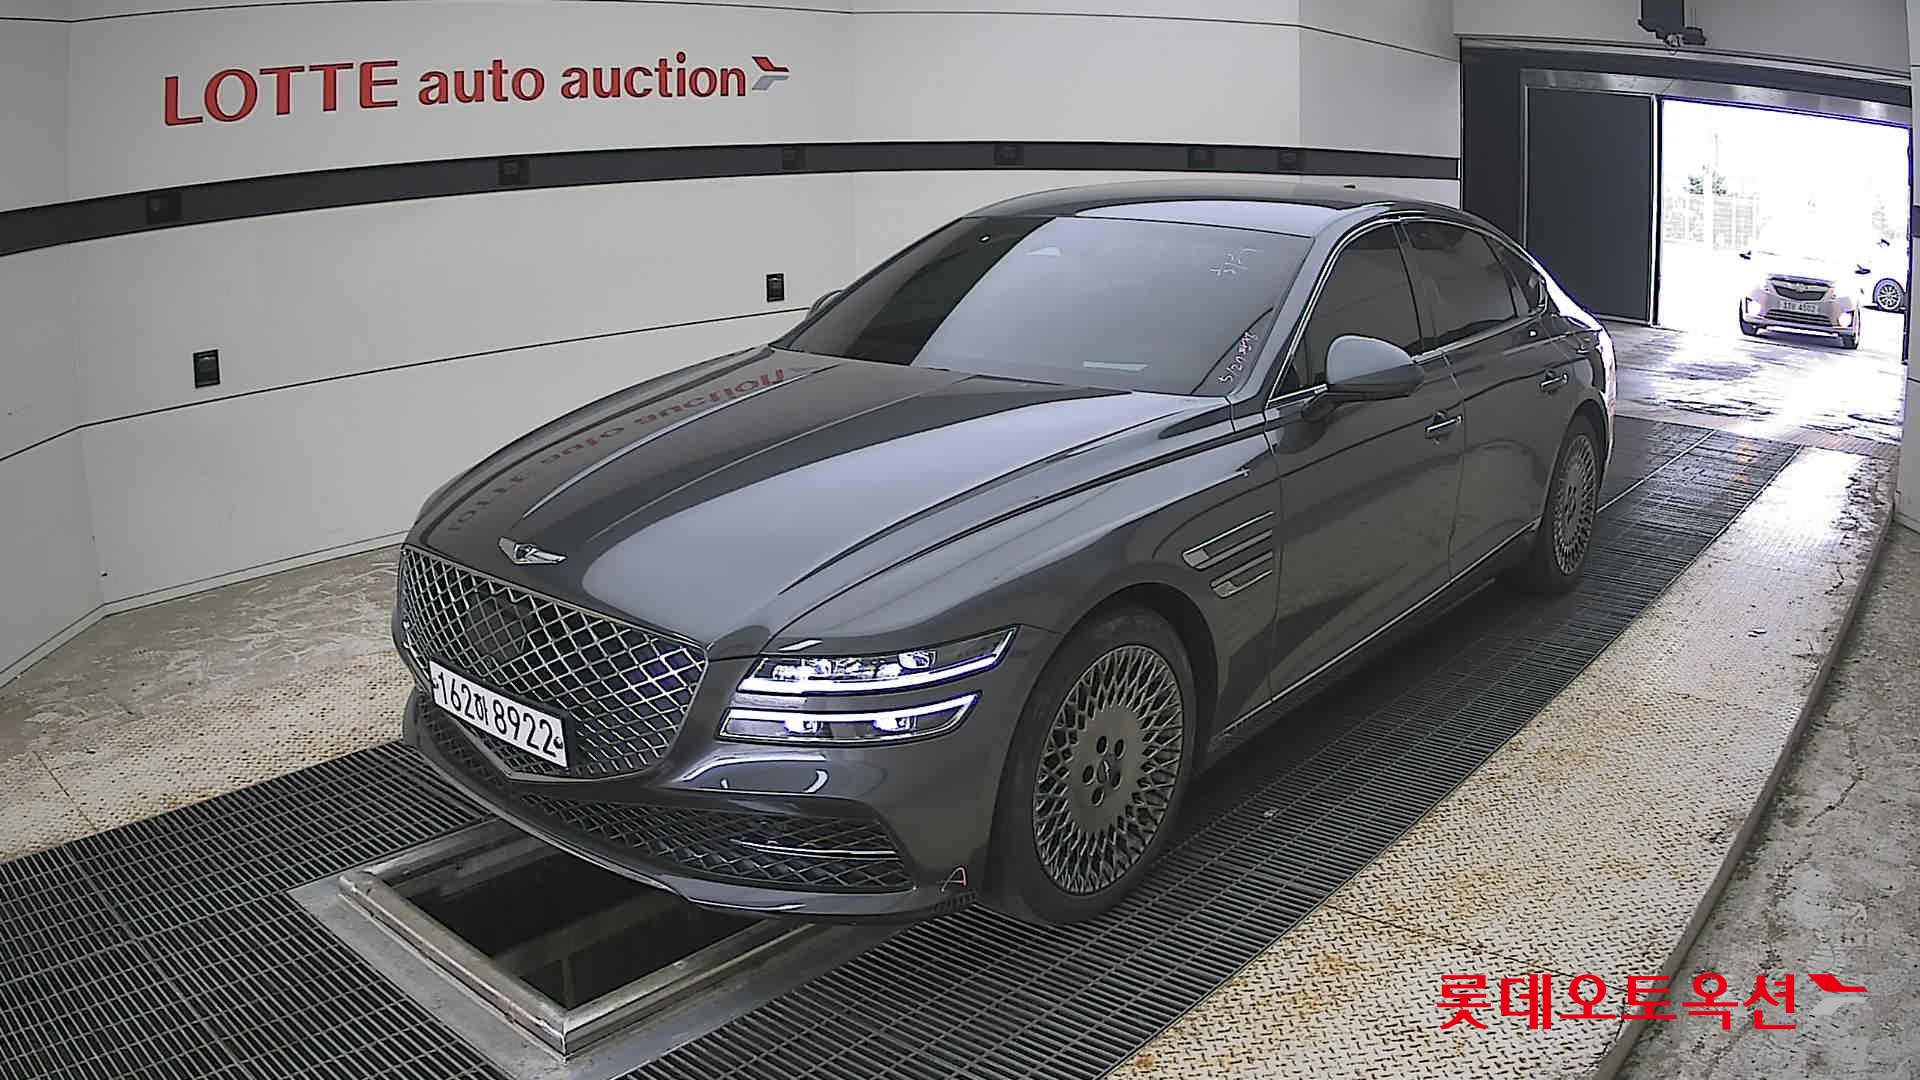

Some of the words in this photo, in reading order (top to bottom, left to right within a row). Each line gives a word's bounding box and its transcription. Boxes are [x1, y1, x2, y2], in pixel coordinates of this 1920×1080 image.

[164, 60, 399, 127] LOTTE
[418, 59, 545, 105] auto
[561, 51, 747, 99] auction
[493, 699, 557, 758] 8922
